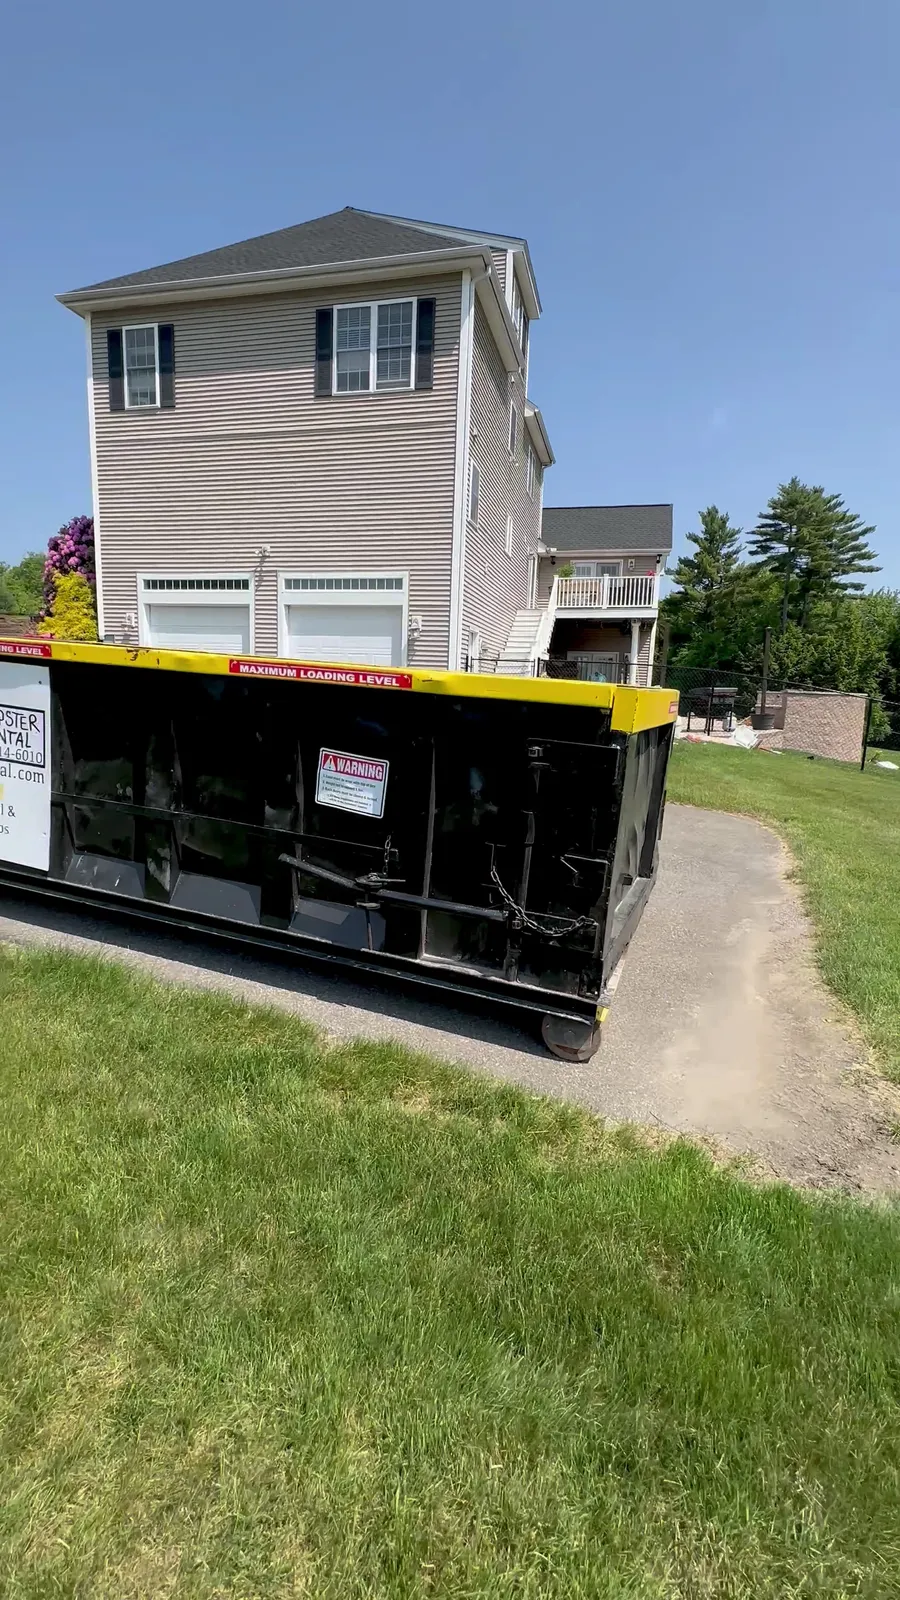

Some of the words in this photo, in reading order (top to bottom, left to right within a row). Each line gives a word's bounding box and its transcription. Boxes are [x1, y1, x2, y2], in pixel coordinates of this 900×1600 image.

[0, 645, 14, 653] NG
[16, 646, 44, 656] LEVEL
[239, 664, 297, 678] MAXIMUM
[300, 669, 355, 682] LOADING
[359, 675, 400, 687] LEVEL
[0, 763, 45, 784] al.com
[337, 757, 383, 780] WARNING
[7, 805, 16, 818] &
